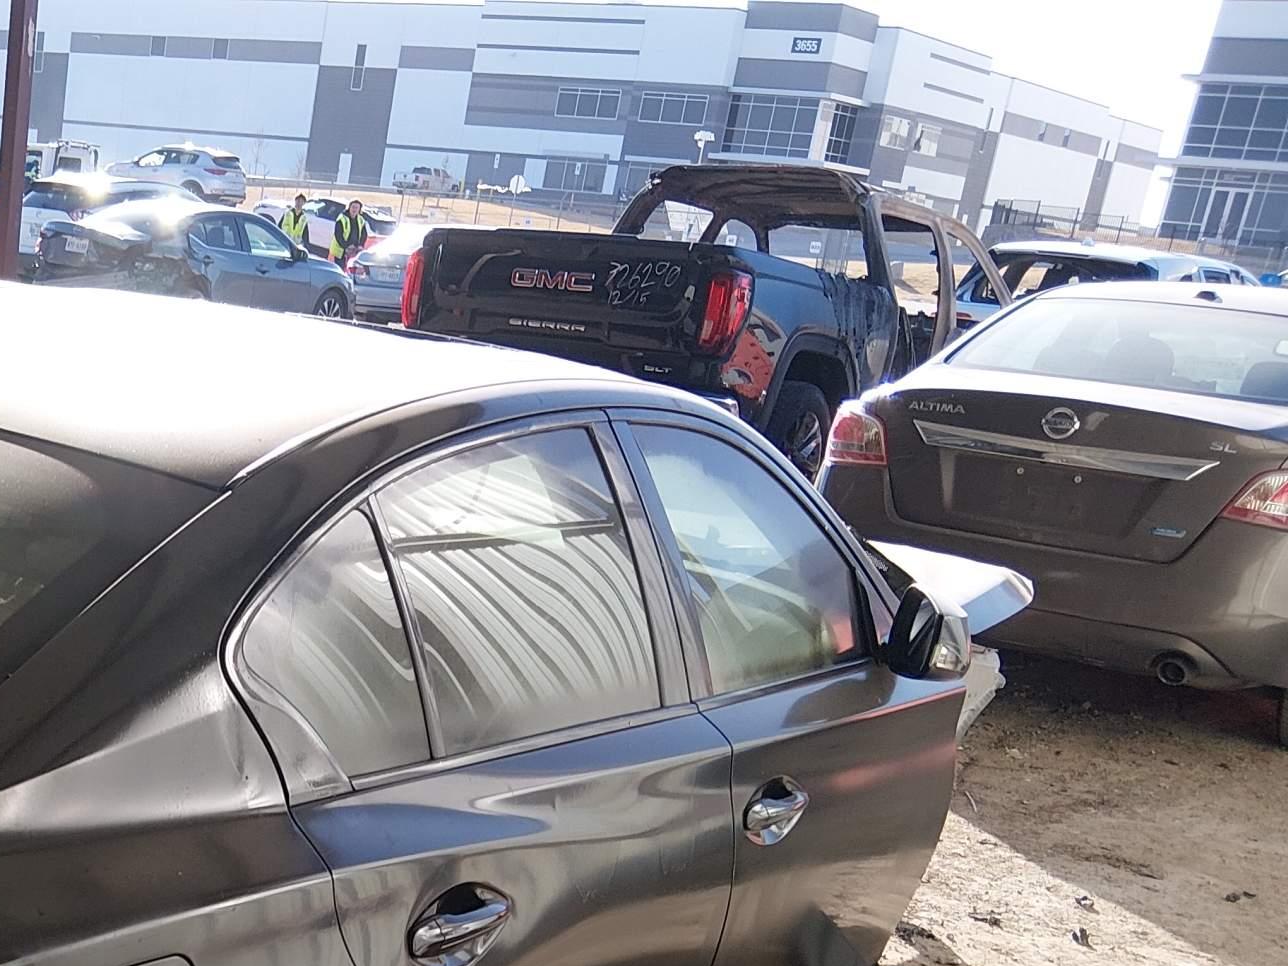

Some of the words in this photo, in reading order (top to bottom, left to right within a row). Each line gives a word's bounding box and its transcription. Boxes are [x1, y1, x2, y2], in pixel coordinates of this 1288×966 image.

[794, 39, 819, 52] 3655
[511, 267, 595, 293] GMC
[509, 317, 585, 332] SIERRA
[909, 400, 966, 415] ALTIMA
[1210, 440, 1237, 454] SL
